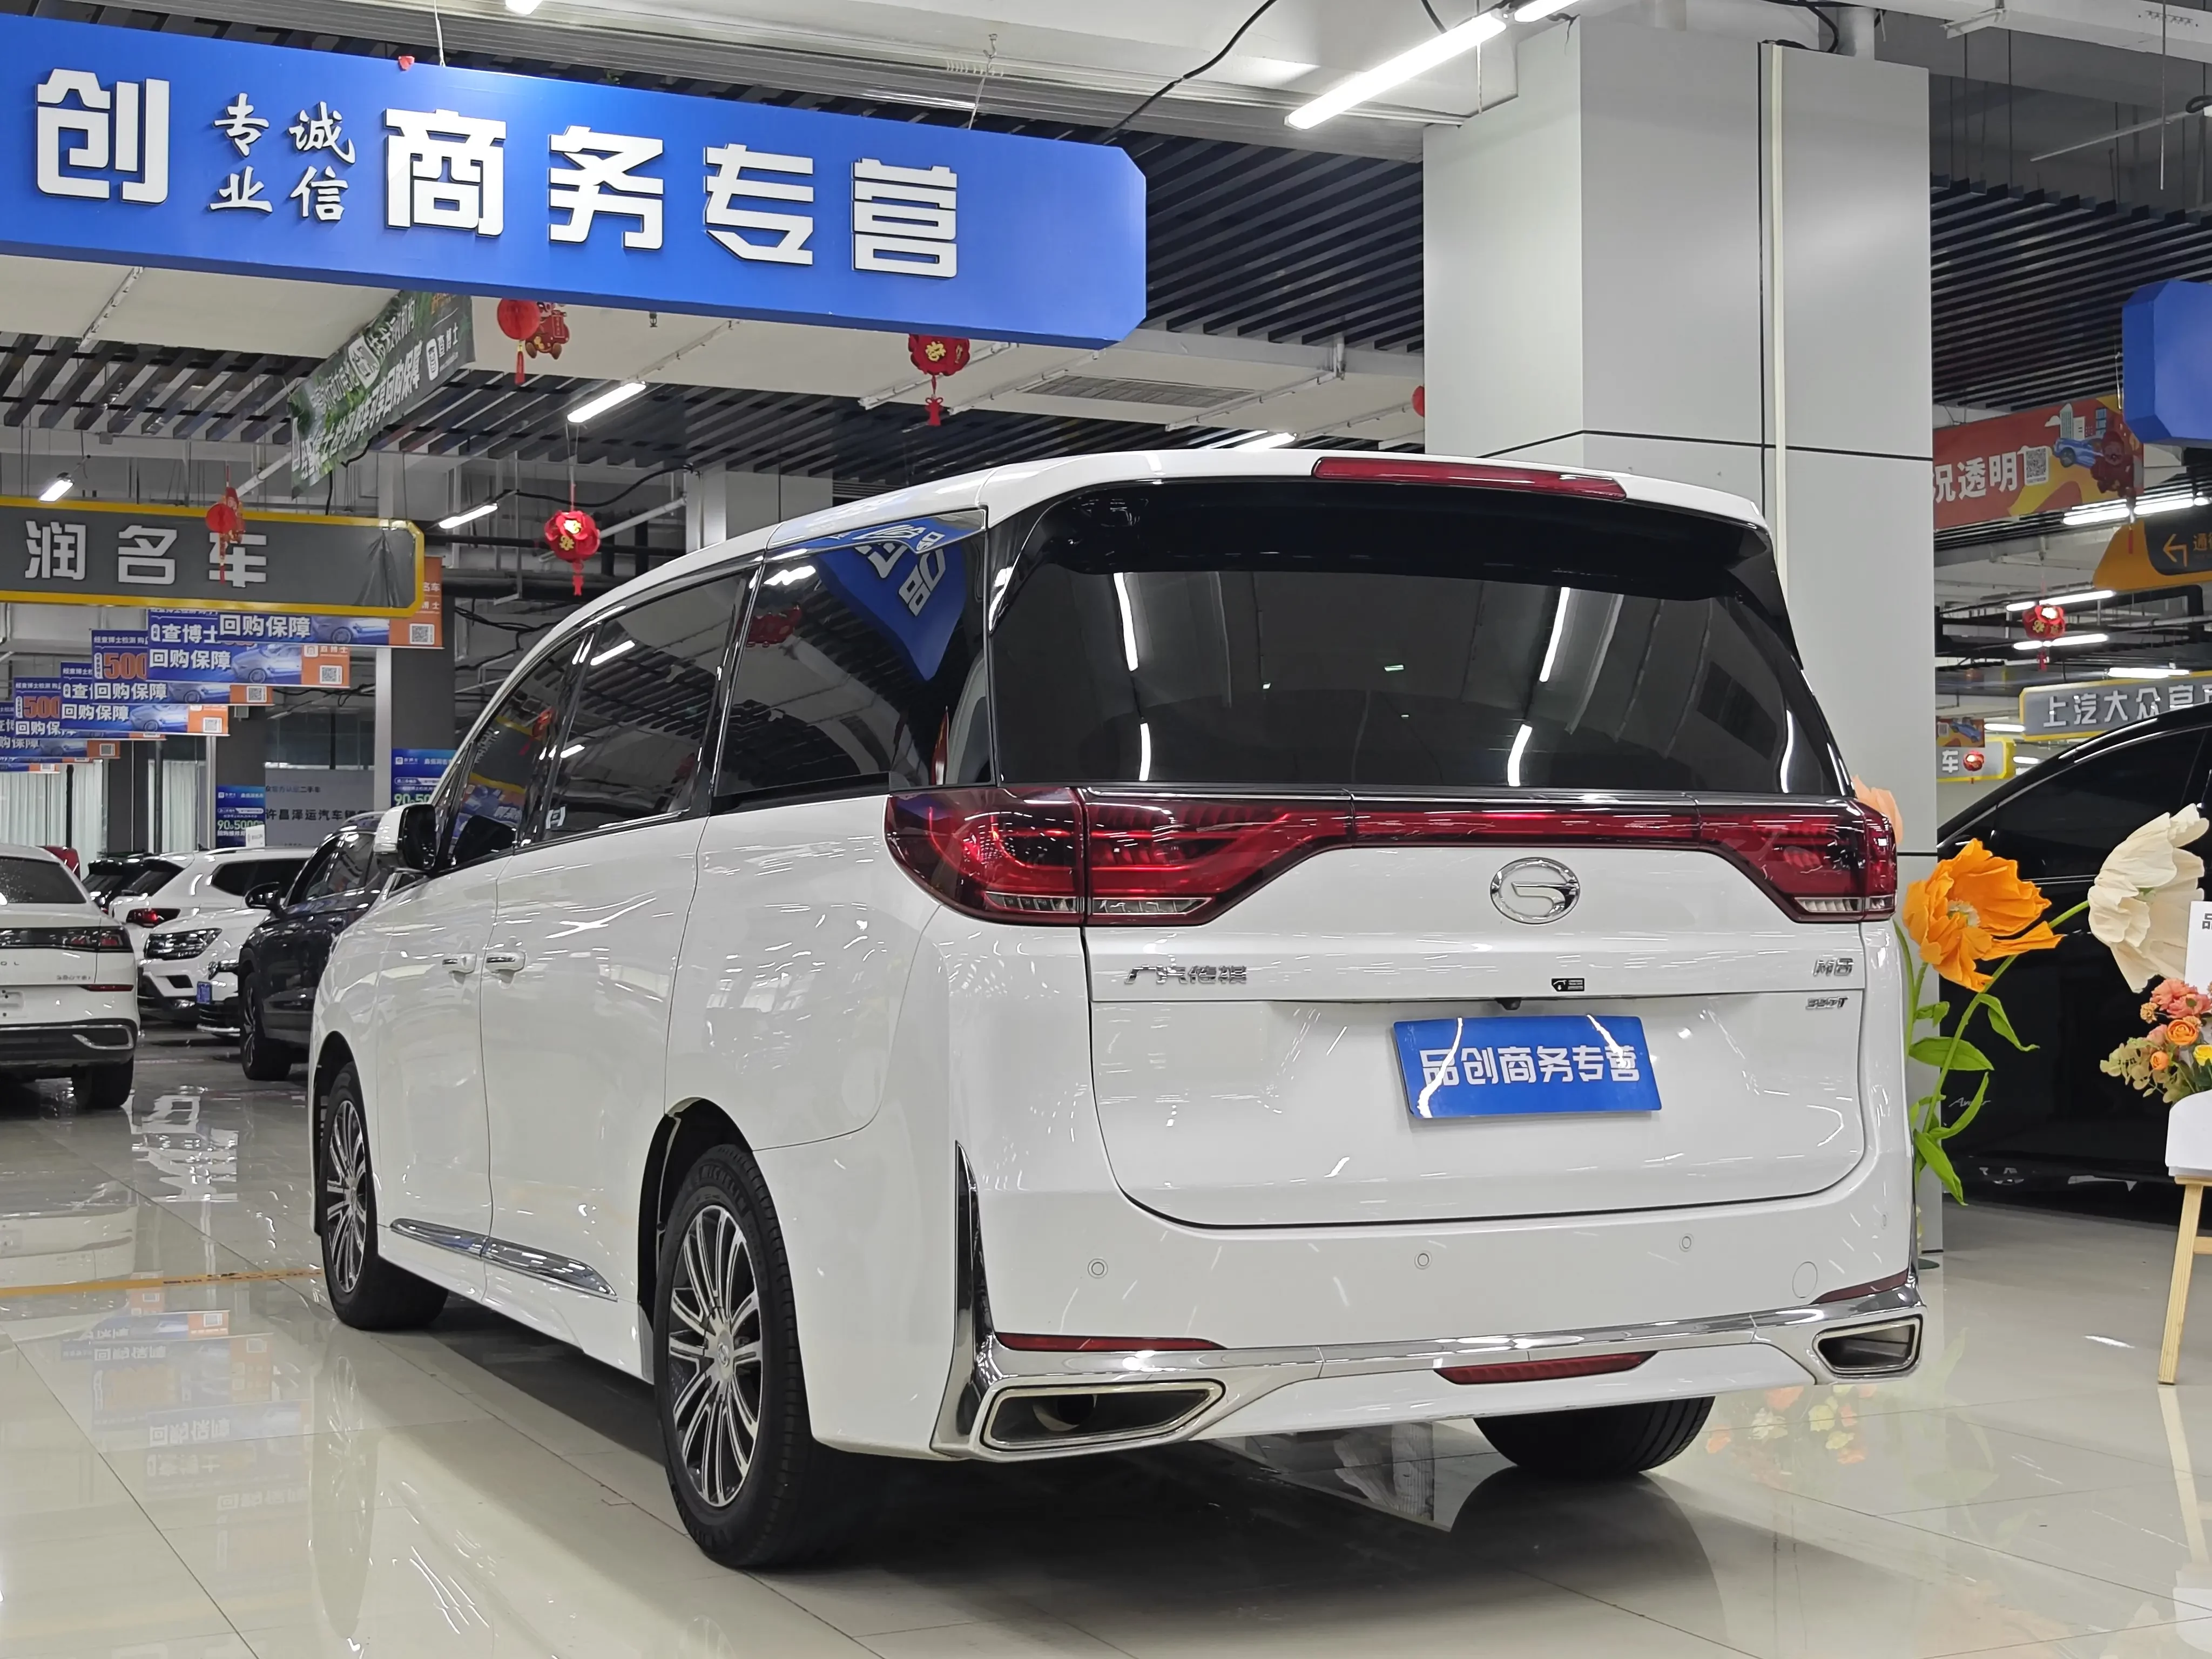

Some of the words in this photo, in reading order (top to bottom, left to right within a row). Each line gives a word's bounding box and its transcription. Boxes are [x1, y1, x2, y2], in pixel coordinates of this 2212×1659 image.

[36, 68, 170, 204] 创
[385, 109, 958, 279] 商务专营
[25, 520, 267, 588] 润名车
[161, 623, 221, 644] 查博士
[220, 615, 311, 638] 回购保障
[149, 649, 231, 670] 回购保障
[93, 683, 167, 700] 回购保障
[62, 704, 129, 721] 回购保障
[1812, 957, 1853, 977] M8
[1419, 1045, 1640, 1087] 品创商务专营
